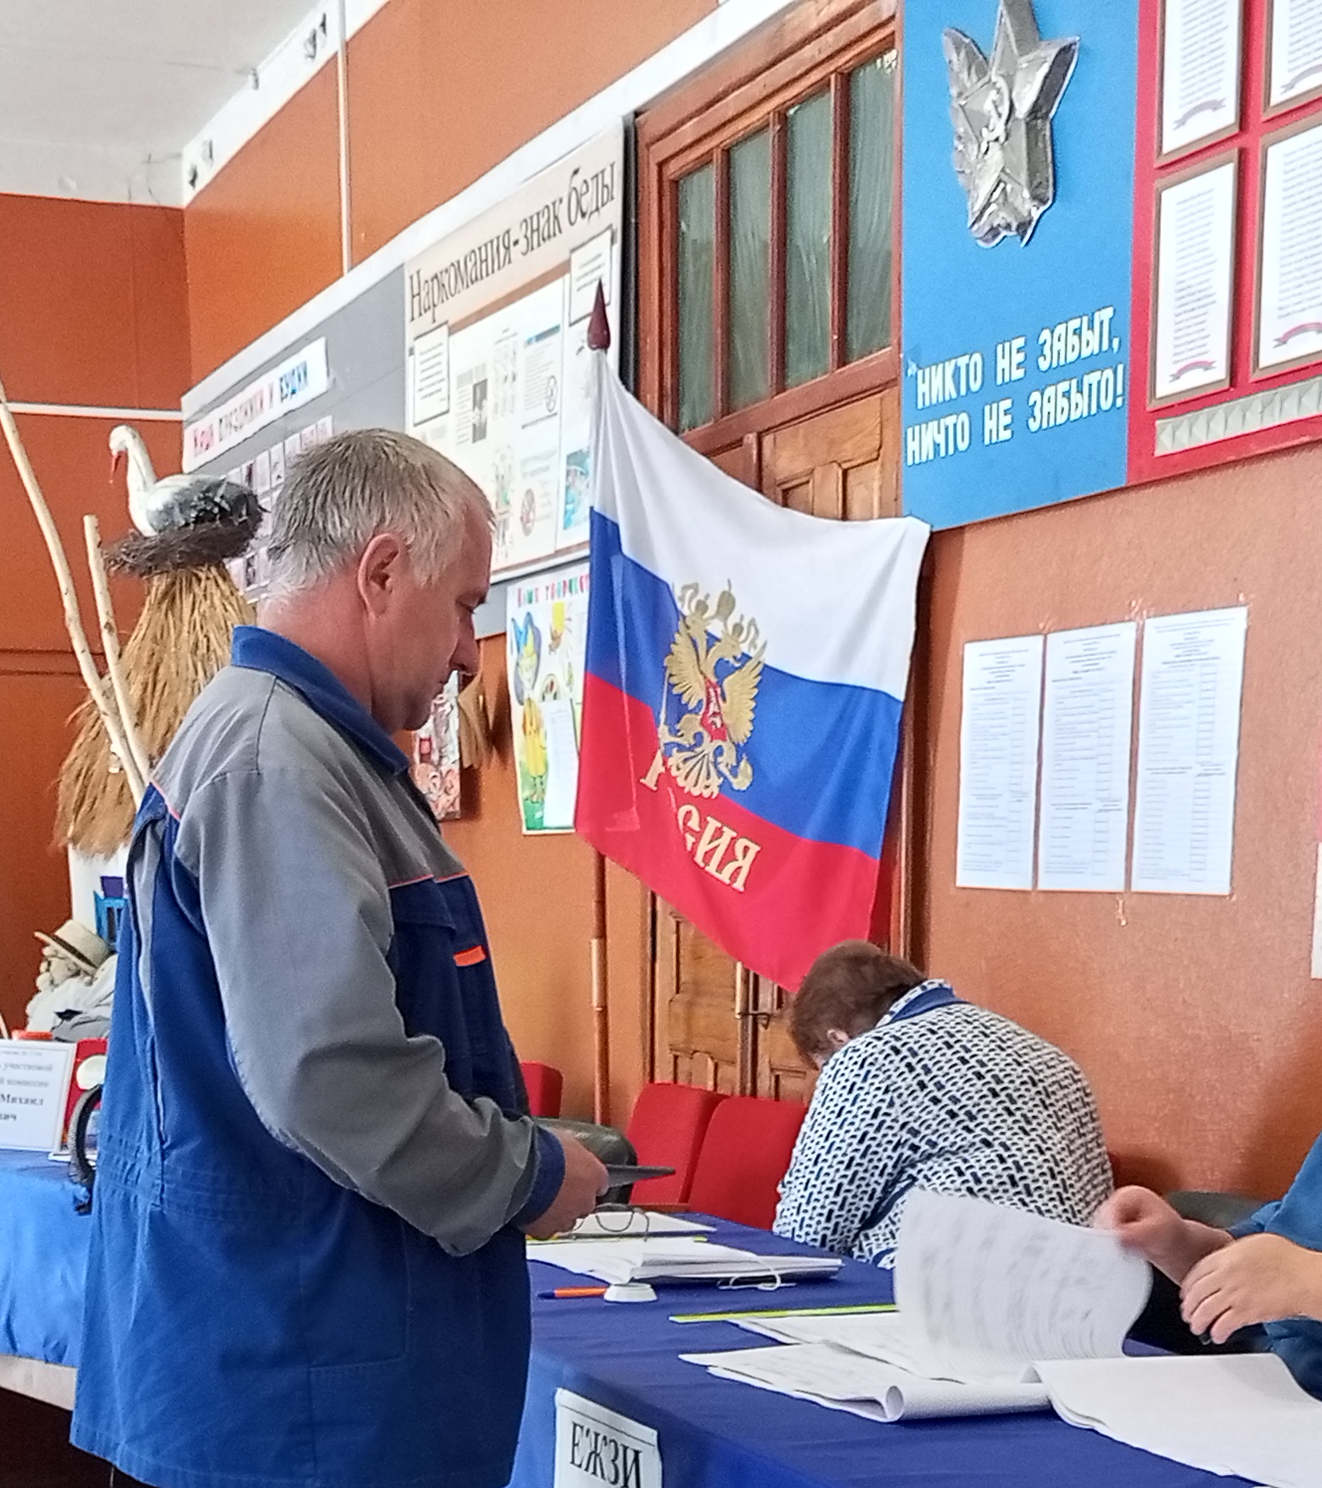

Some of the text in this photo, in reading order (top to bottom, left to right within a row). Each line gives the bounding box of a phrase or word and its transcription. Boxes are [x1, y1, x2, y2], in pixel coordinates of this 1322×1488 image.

[409, 198, 563, 323] Наркомания-знак
[567, 161, 616, 227] беды
[995, 336, 1026, 386] НЕ
[1037, 305, 1120, 372] ЗАБЫТ,
[906, 363, 1124, 466] НИЧТО НЕ ЗАБЫТО!
[0, 1093, 44, 1106] Михаил
